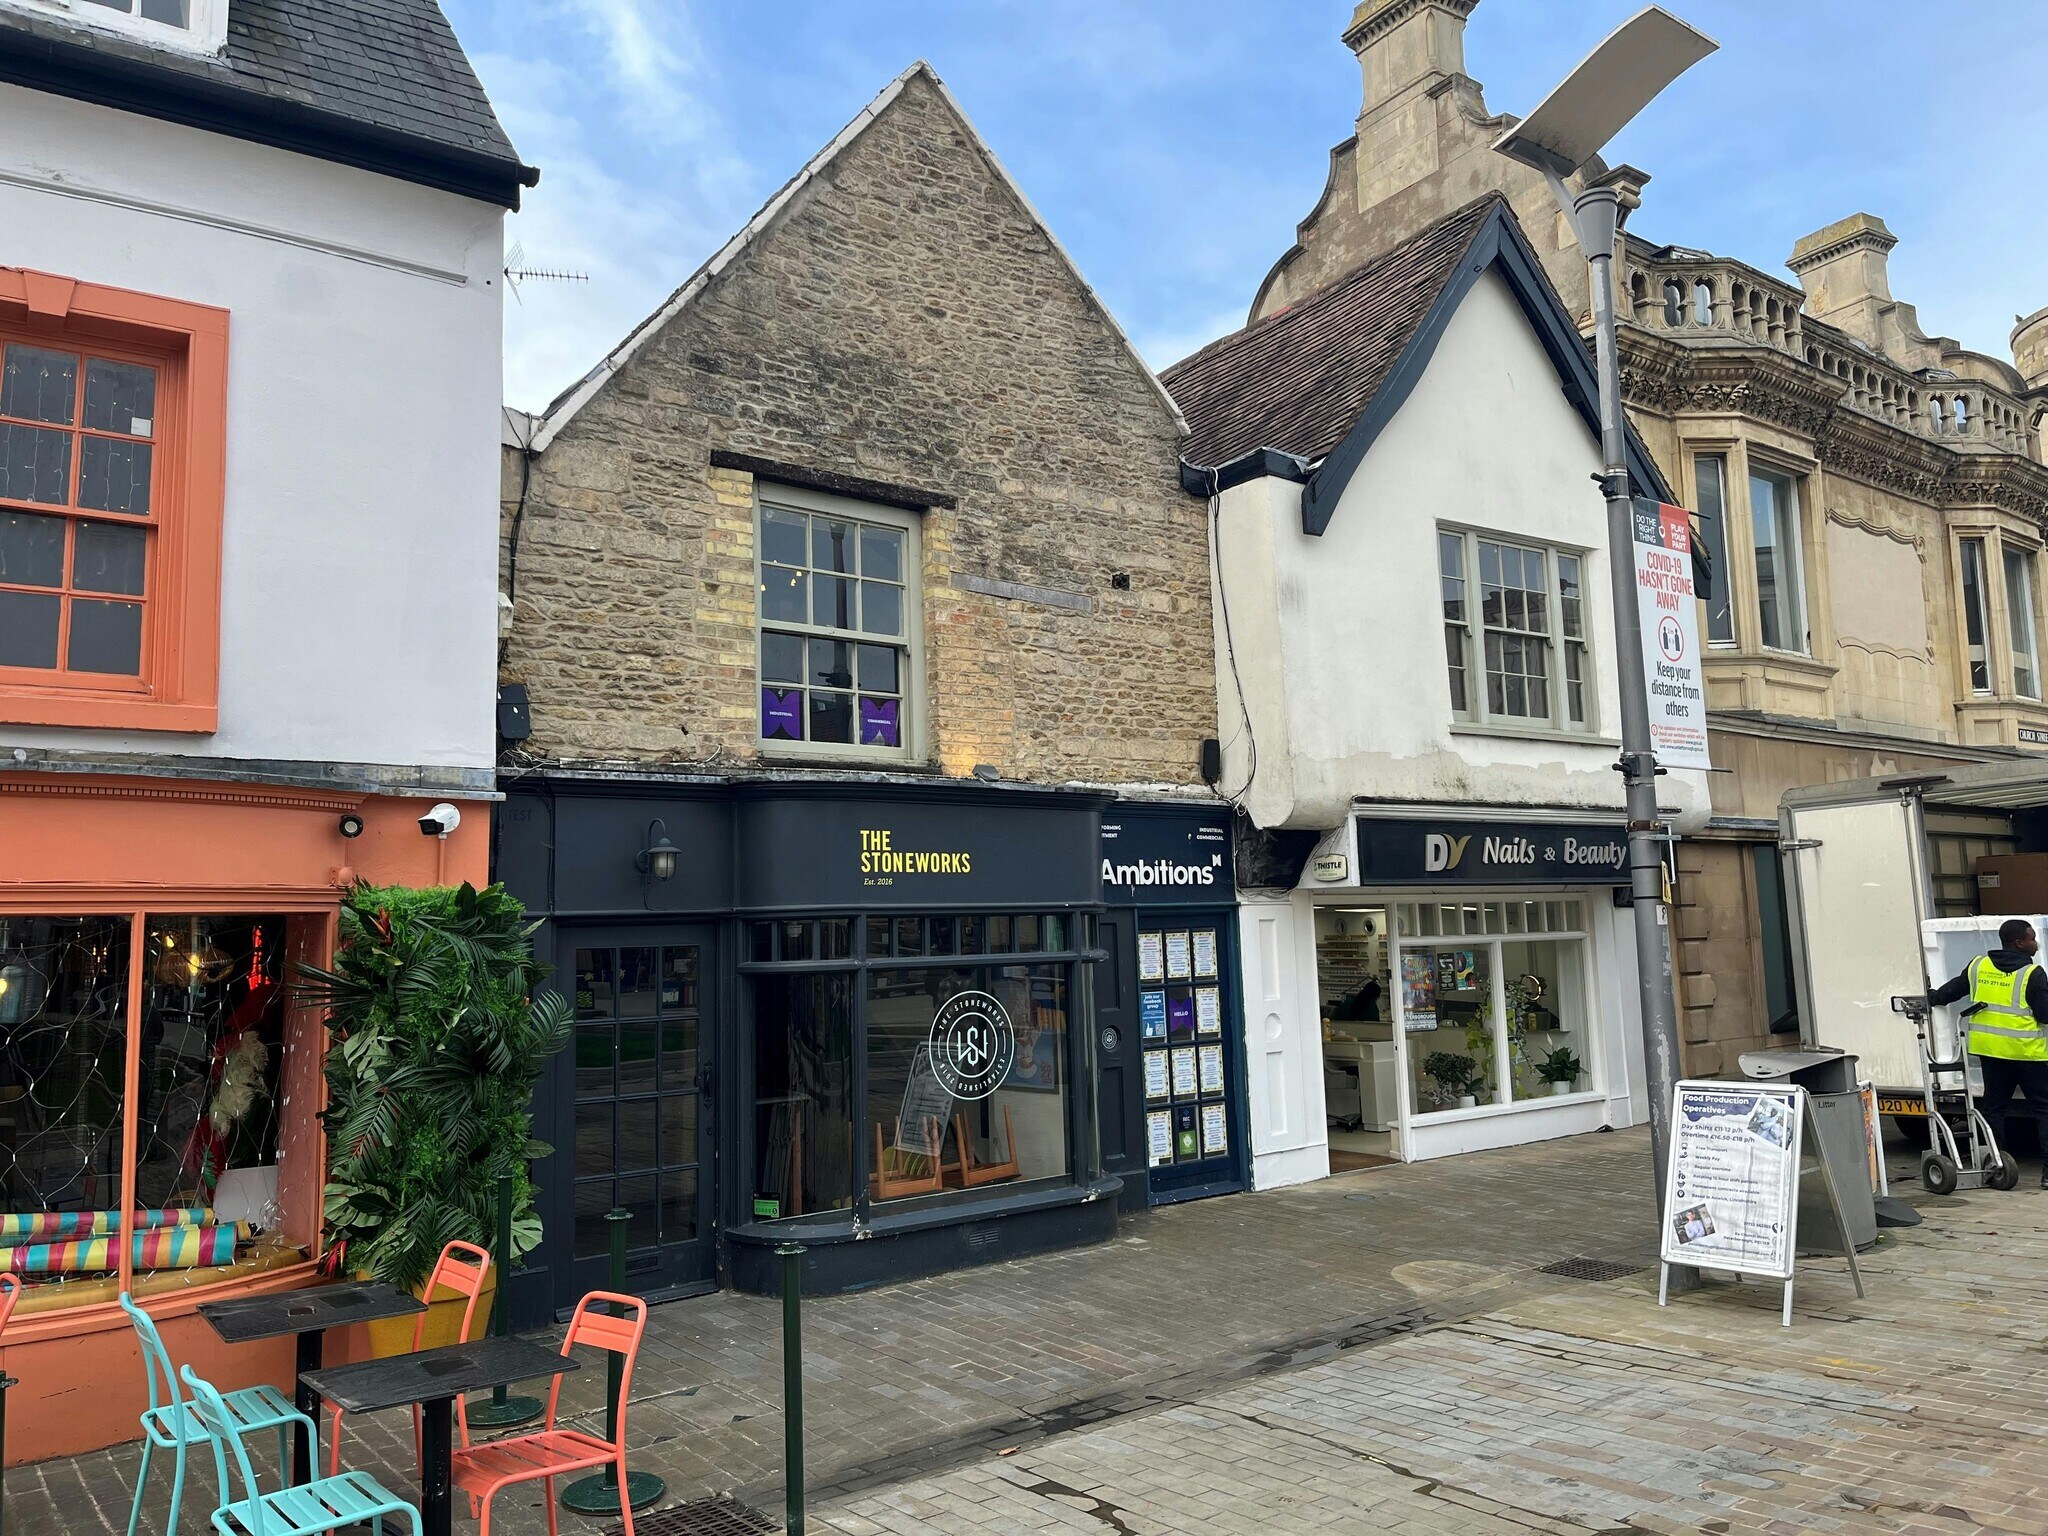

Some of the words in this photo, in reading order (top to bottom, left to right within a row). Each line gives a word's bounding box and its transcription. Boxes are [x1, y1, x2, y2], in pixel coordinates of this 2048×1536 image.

[1636, 514, 1645, 524] DO
[1646, 516, 1656, 526] THE
[1639, 524, 1655, 534] RIGHT
[1670, 524, 1684, 534] PLAY
[1639, 532, 1656, 544] THING
[1672, 533, 1686, 542] YOUR
[1672, 540, 1686, 550] PART
[1646, 552, 1682, 575] COVID-19
[1639, 568, 1669, 591] HASN'T
[1671, 575, 1692, 596] GONE
[1657, 591, 1679, 612] AWAY
[1656, 661, 1674, 680] Keep
[1676, 666, 1691, 682] your
[1652, 680, 1681, 698] distance
[1682, 683, 1699, 700] from
[1666, 701, 1689, 717] others
[860, 830, 891, 850] THE
[861, 852, 971, 873] STONEWORKS
[1426, 834, 1472, 872] DY
[1482, 836, 1535, 864] Nails
[1544, 847, 1555, 861] &
[1564, 838, 1626, 870] Beauty
[1102, 859, 1214, 884] Ambitions
[939, 1012, 952, 1030] THE
[954, 1000, 1004, 1027] STONEWORKS
[958, 1058, 1005, 1091] ESTABLISHED
[1683, 1105, 1726, 1114] Operatives
[1705, 1096, 1749, 1104] Production
[1878, 1101, 1902, 1112] U20
